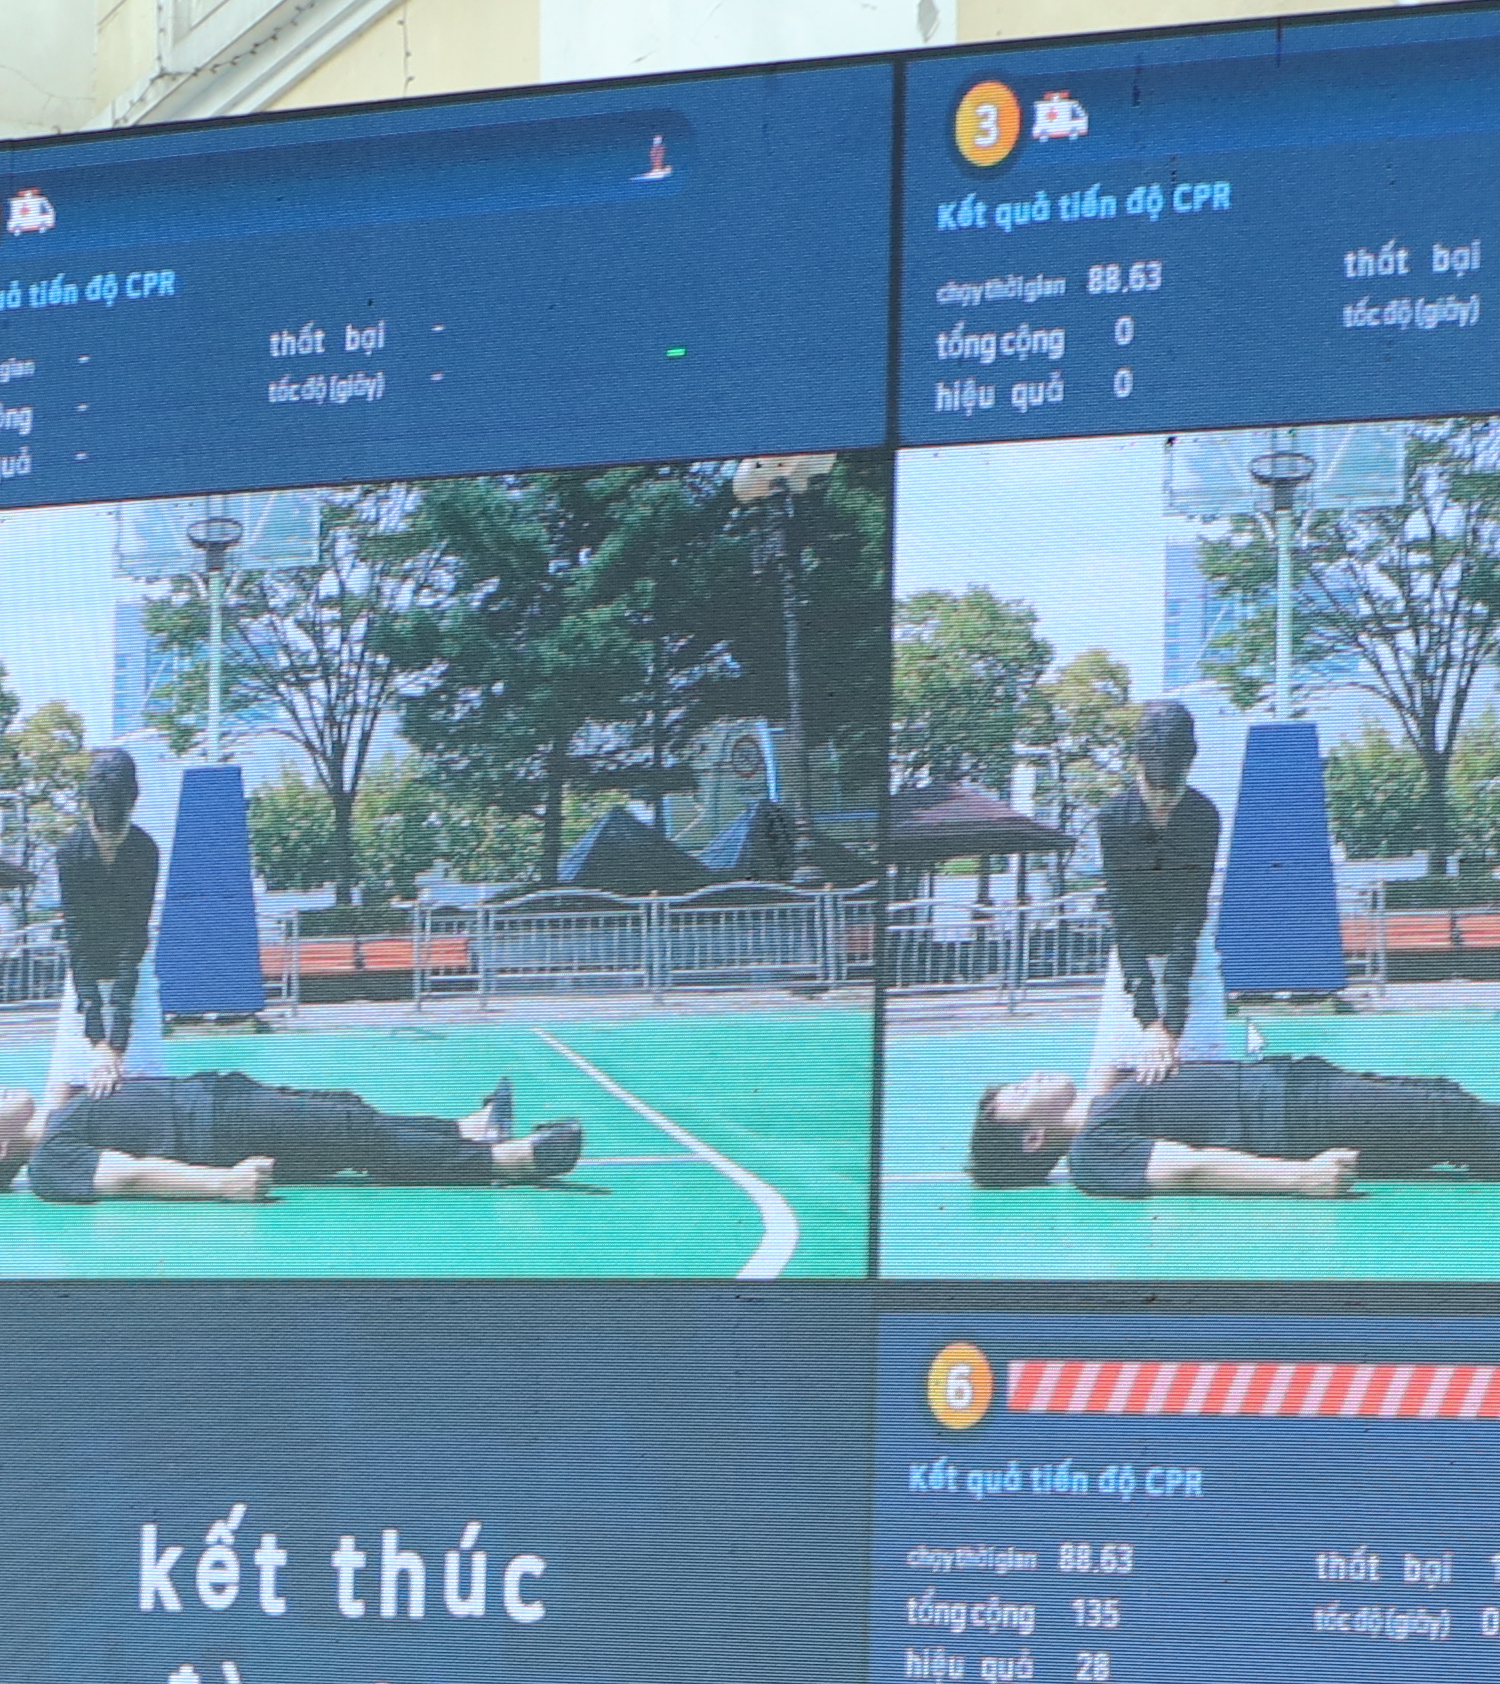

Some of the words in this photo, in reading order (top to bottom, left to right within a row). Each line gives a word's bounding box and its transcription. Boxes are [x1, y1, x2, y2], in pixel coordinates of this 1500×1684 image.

[973, 103, 999, 147] 3
[937, 193, 988, 231] Kết
[995, 190, 1051, 232] quả
[1058, 183, 1117, 222] tiến
[1126, 183, 1164, 222] độ
[1173, 181, 1232, 214] CPR
[28, 273, 79, 309] tiến
[85, 272, 119, 307] độ
[125, 269, 176, 299] CPR
[1088, 261, 1162, 294] 88.63
[1114, 315, 1135, 346] 0
[1113, 367, 1133, 398] 0
[946, 1363, 974, 1411] 6
[1144, 1465, 1204, 1498] CPR
[138, 1502, 287, 1615] kết
[331, 1520, 548, 1624] thúc
[1058, 1541, 1134, 1574] 88.63
[1071, 1597, 1121, 1628] 135
[1075, 1650, 1111, 1682] 28
